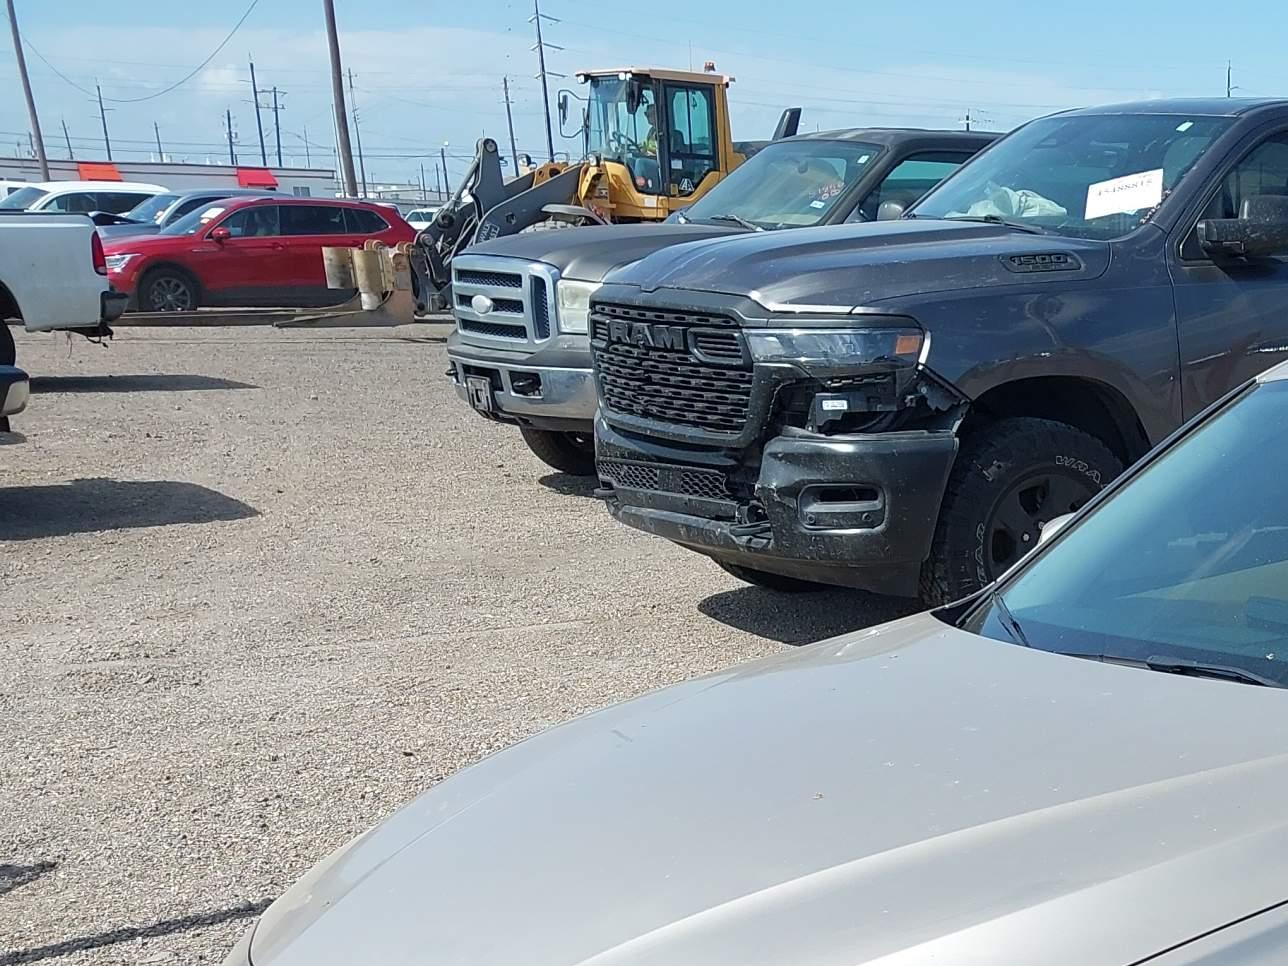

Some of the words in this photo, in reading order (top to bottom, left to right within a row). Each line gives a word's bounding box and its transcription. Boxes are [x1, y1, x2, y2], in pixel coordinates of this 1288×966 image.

[1009, 254, 1067, 266] 1500
[609, 319, 688, 350] RAM
[1055, 455, 1108, 489] WRA
